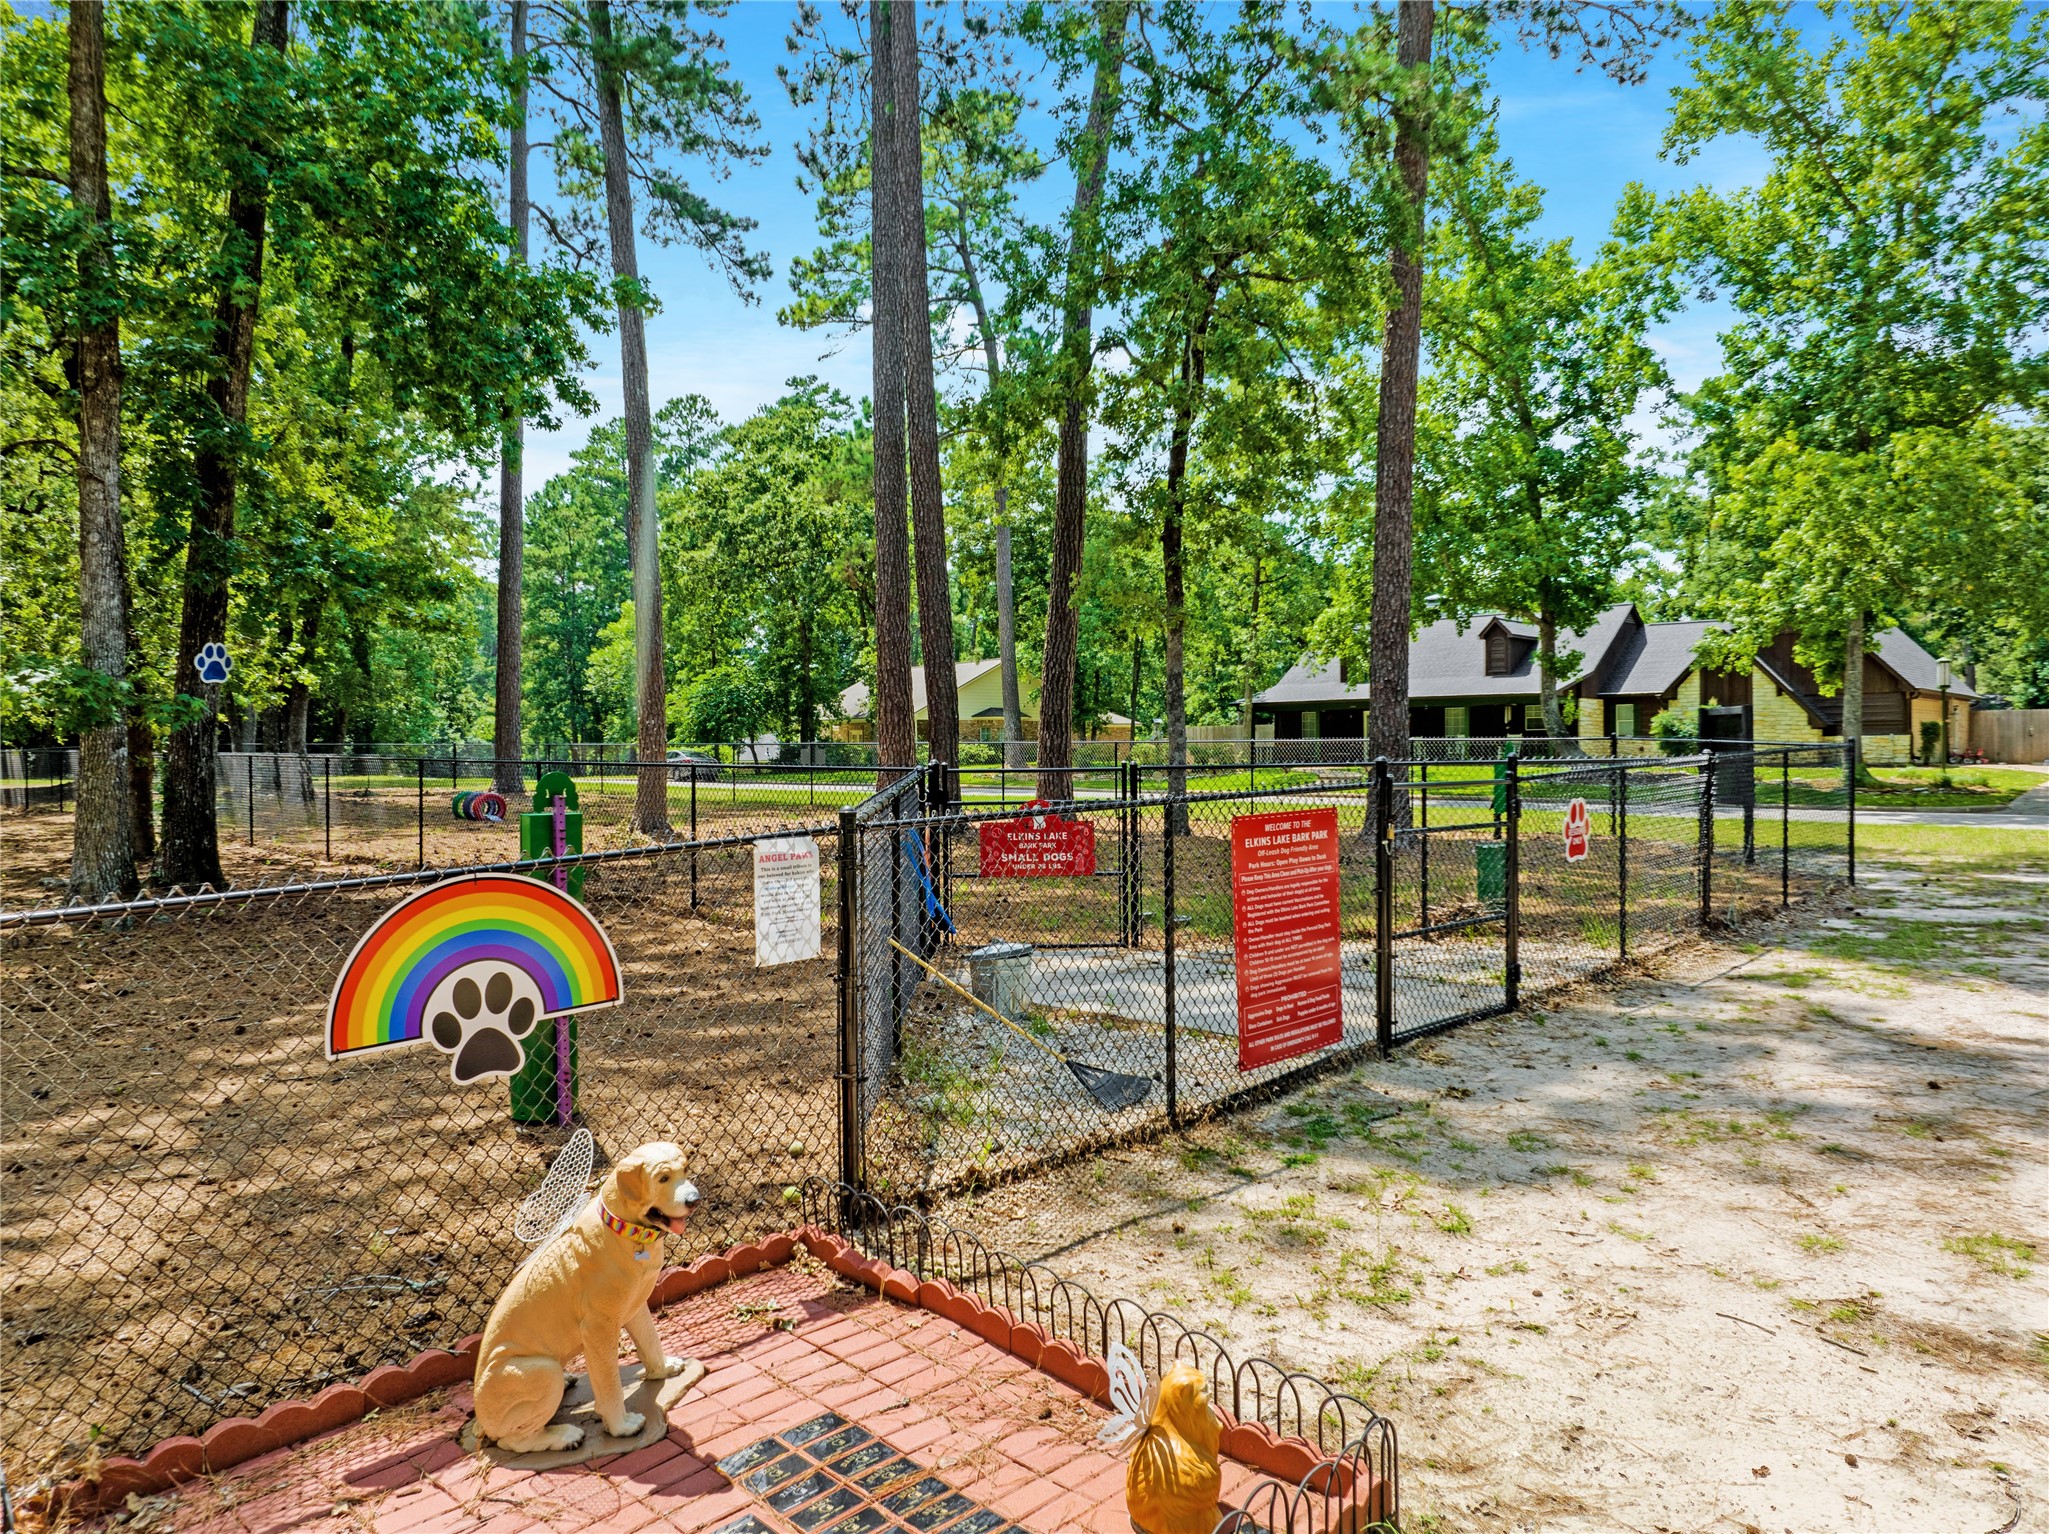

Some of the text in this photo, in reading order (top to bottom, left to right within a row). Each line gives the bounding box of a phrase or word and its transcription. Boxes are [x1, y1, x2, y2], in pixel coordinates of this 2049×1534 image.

[1265, 820, 1311, 831] WELCOME TO THE
[1044, 832, 1068, 840] LAKE
[1245, 830, 1328, 848] ELKINS LAKE BARK PARK
[1281, 847, 1290, 855] Dog
[1291, 845, 1308, 854] Friendly
[759, 851, 813, 863] ANGEL PAWS
[1001, 853, 1073, 862] SMALL DOGS
